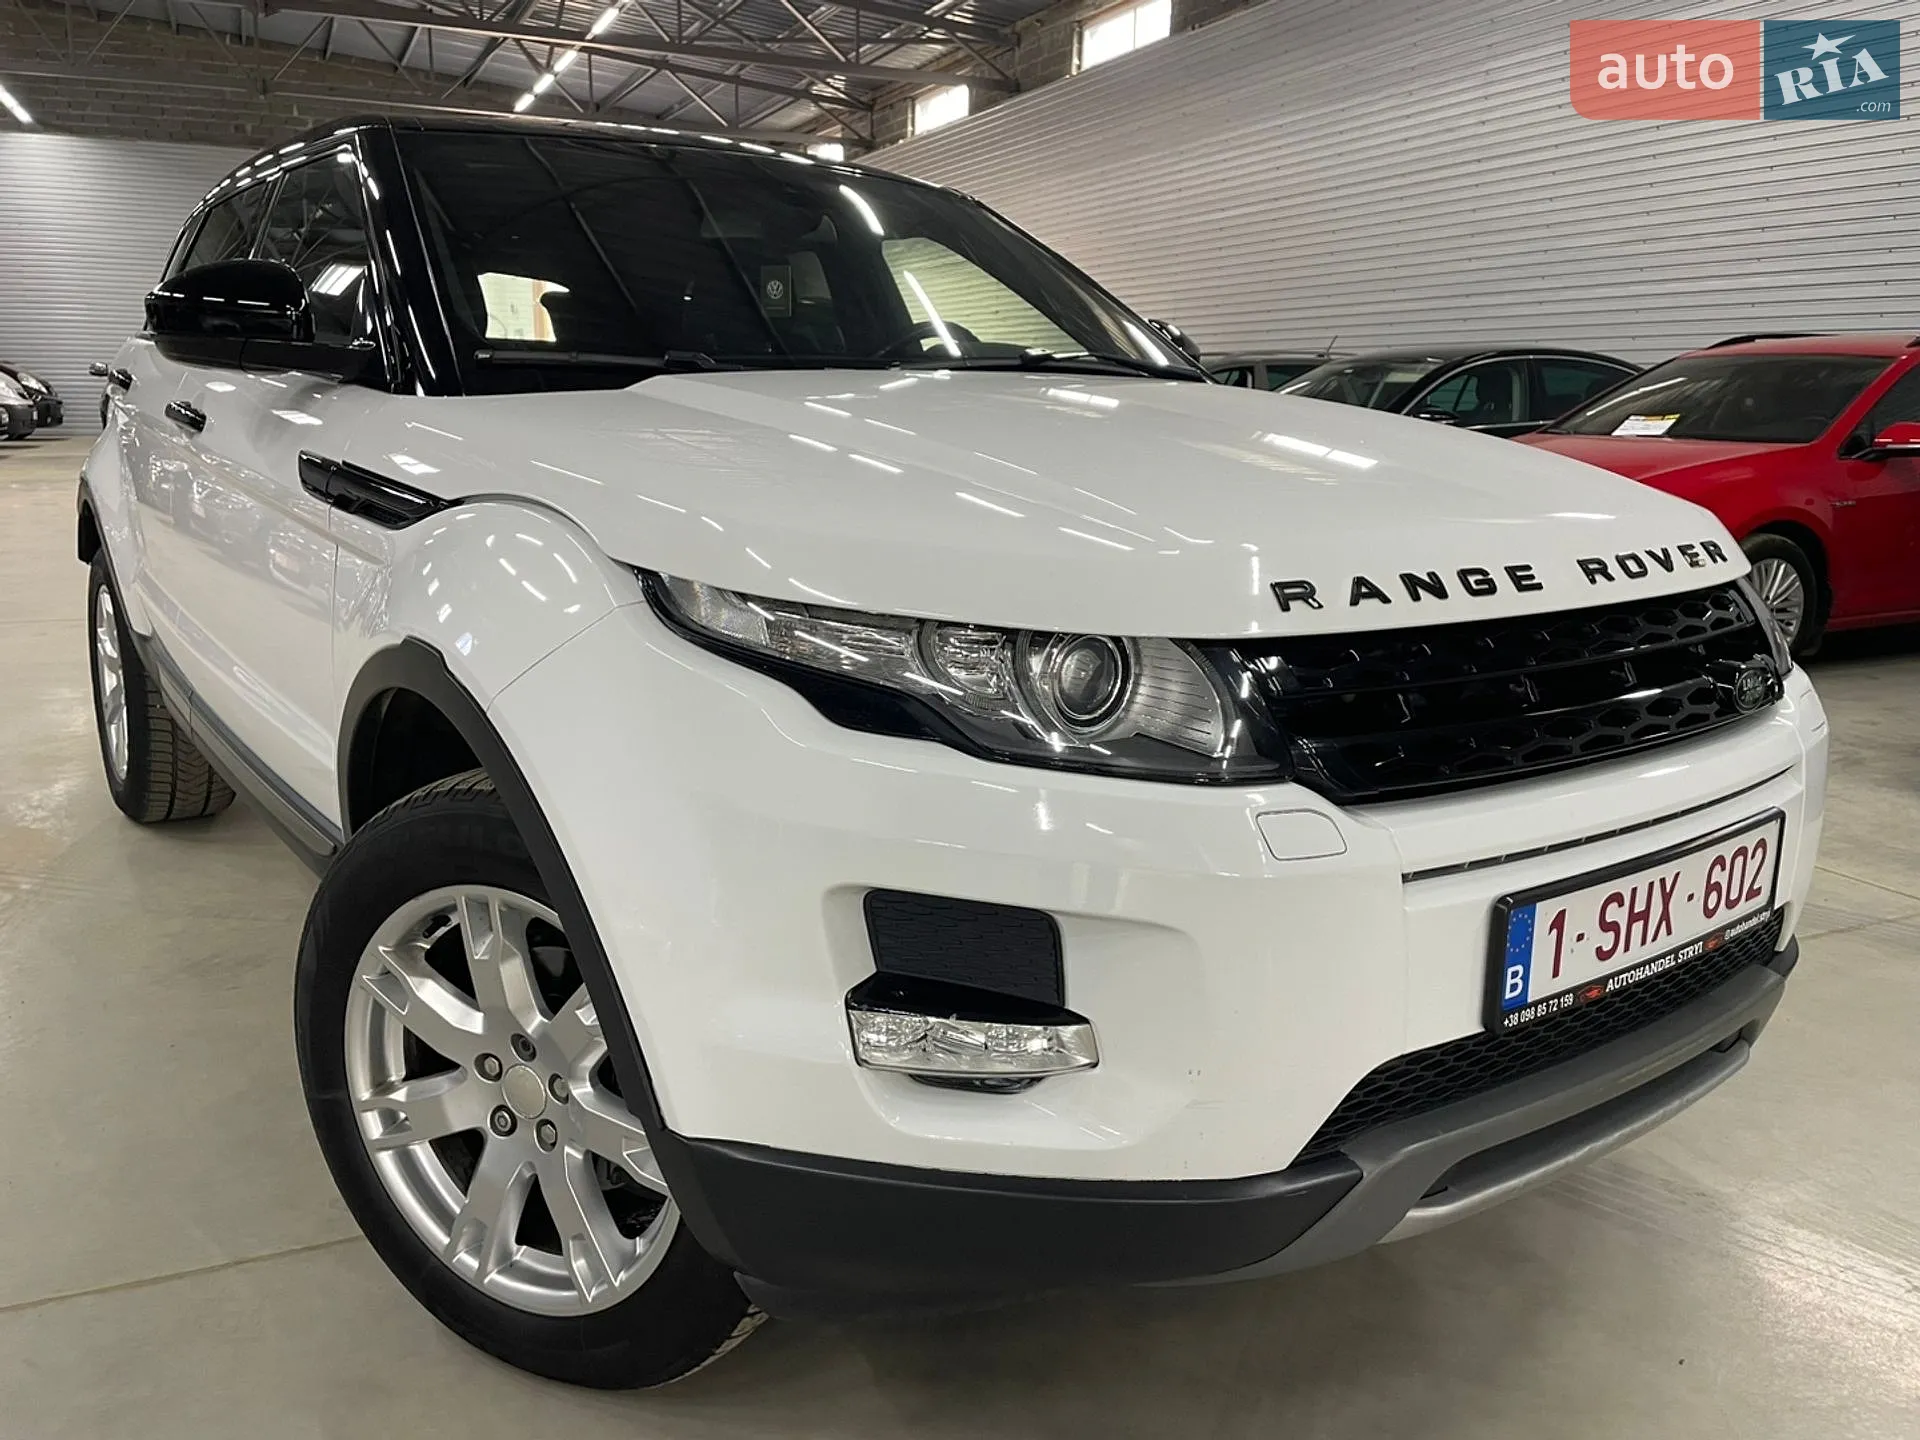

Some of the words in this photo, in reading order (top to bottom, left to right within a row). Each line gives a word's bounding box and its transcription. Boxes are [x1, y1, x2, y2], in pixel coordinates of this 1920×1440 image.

[1269, 564, 1544, 612] RANGE
[1577, 539, 1729, 586] ROVER
[1548, 837, 1768, 980] 1-SHX-602
[1503, 1012, 1519, 1028] +38
[1520, 1006, 1536, 1023] 098
[1548, 998, 1559, 1013] 72
[1606, 953, 1676, 992] AUTOHANDEL
[1504, 964, 1524, 1000] B
